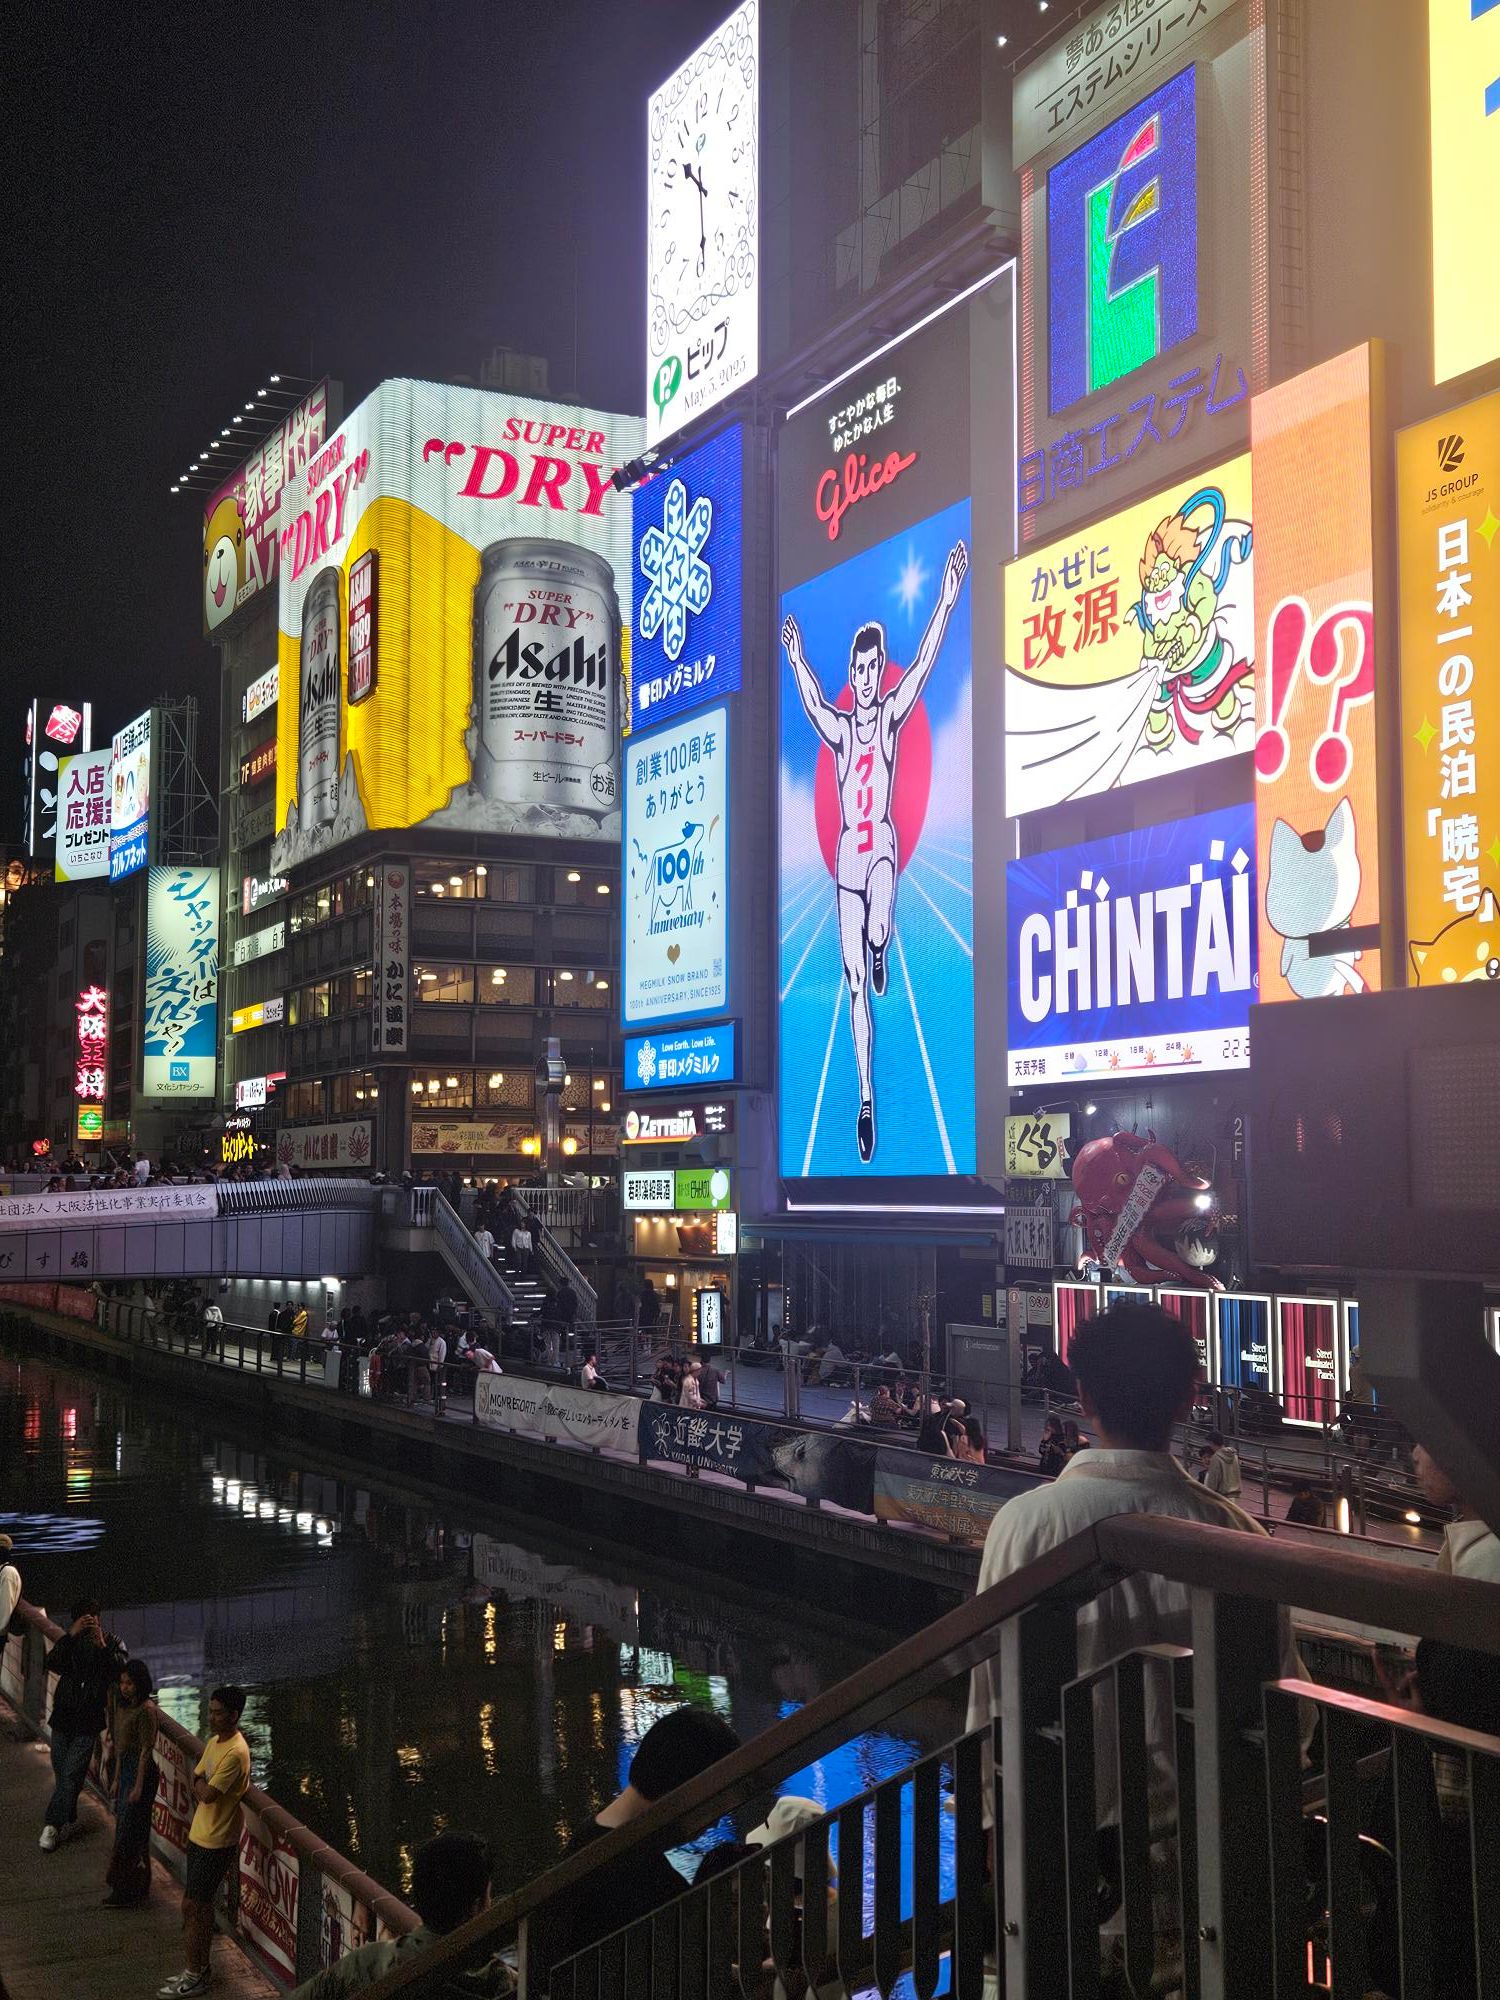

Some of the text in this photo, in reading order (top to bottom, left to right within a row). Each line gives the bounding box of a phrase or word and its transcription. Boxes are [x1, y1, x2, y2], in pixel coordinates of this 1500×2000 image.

[695, 92, 708, 124] 12
[716, 88, 724, 114] 1
[727, 104, 740, 131] 2
[678, 119, 690, 149] 11
[663, 158, 678, 189] 10
[664, 241, 677, 265] 8
[678, 258, 690, 282] 7
[688, 316, 730, 380] ピップ
[685, 387, 705, 412] May
[720, 355, 746, 386] 2025
[828, 376, 902, 434] すこやかな毎日、
[502, 417, 606, 454] SUPER
[833, 403, 895, 452] ゆたかな人生
[1018, 353, 1249, 513] 日商エステム
[307, 434, 346, 496] SUPER
[816, 451, 917, 540] Glico
[1425, 473, 1479, 502] JS GROUP
[350, 563, 371, 611] ASAHI
[1031, 545, 1111, 602] かぜに
[528, 590, 573, 604] SUPER
[504, 602, 594, 629] “DRY”
[1022, 577, 1120, 670] 改源
[350, 613, 371, 658] 1889
[489, 627, 606, 691] Asahi
[303, 653, 337, 719] Asahi
[639, 654, 717, 710] 印メグミルク
[534, 690, 563, 713] 生
[514, 730, 584, 747] スーパードライ
[635, 731, 717, 786] 創業100周年
[67, 765, 105, 798] 入店
[592, 771, 615, 797] お酒
[645, 775, 707, 819] ありがとう
[855, 745, 875, 854] グリコ
[66, 829, 109, 848] プレゼント
[112, 839, 147, 878] ガルフネット
[646, 910, 704, 937] Anniversary
[639, 970, 709, 991] MEGMILK SNOW BRAND
[662, 1043, 673, 1052] Love
[691, 1039, 703, 1049] Love
[659, 1053, 720, 1079] 雪印メグミルク
[1015, 1058, 1046, 1076] 天気予報
[156, 1083, 204, 1092] 文化シャッター
[640, 1115, 697, 1137] ZETTERIA
[674, 1416, 743, 1459] 近畿大学
